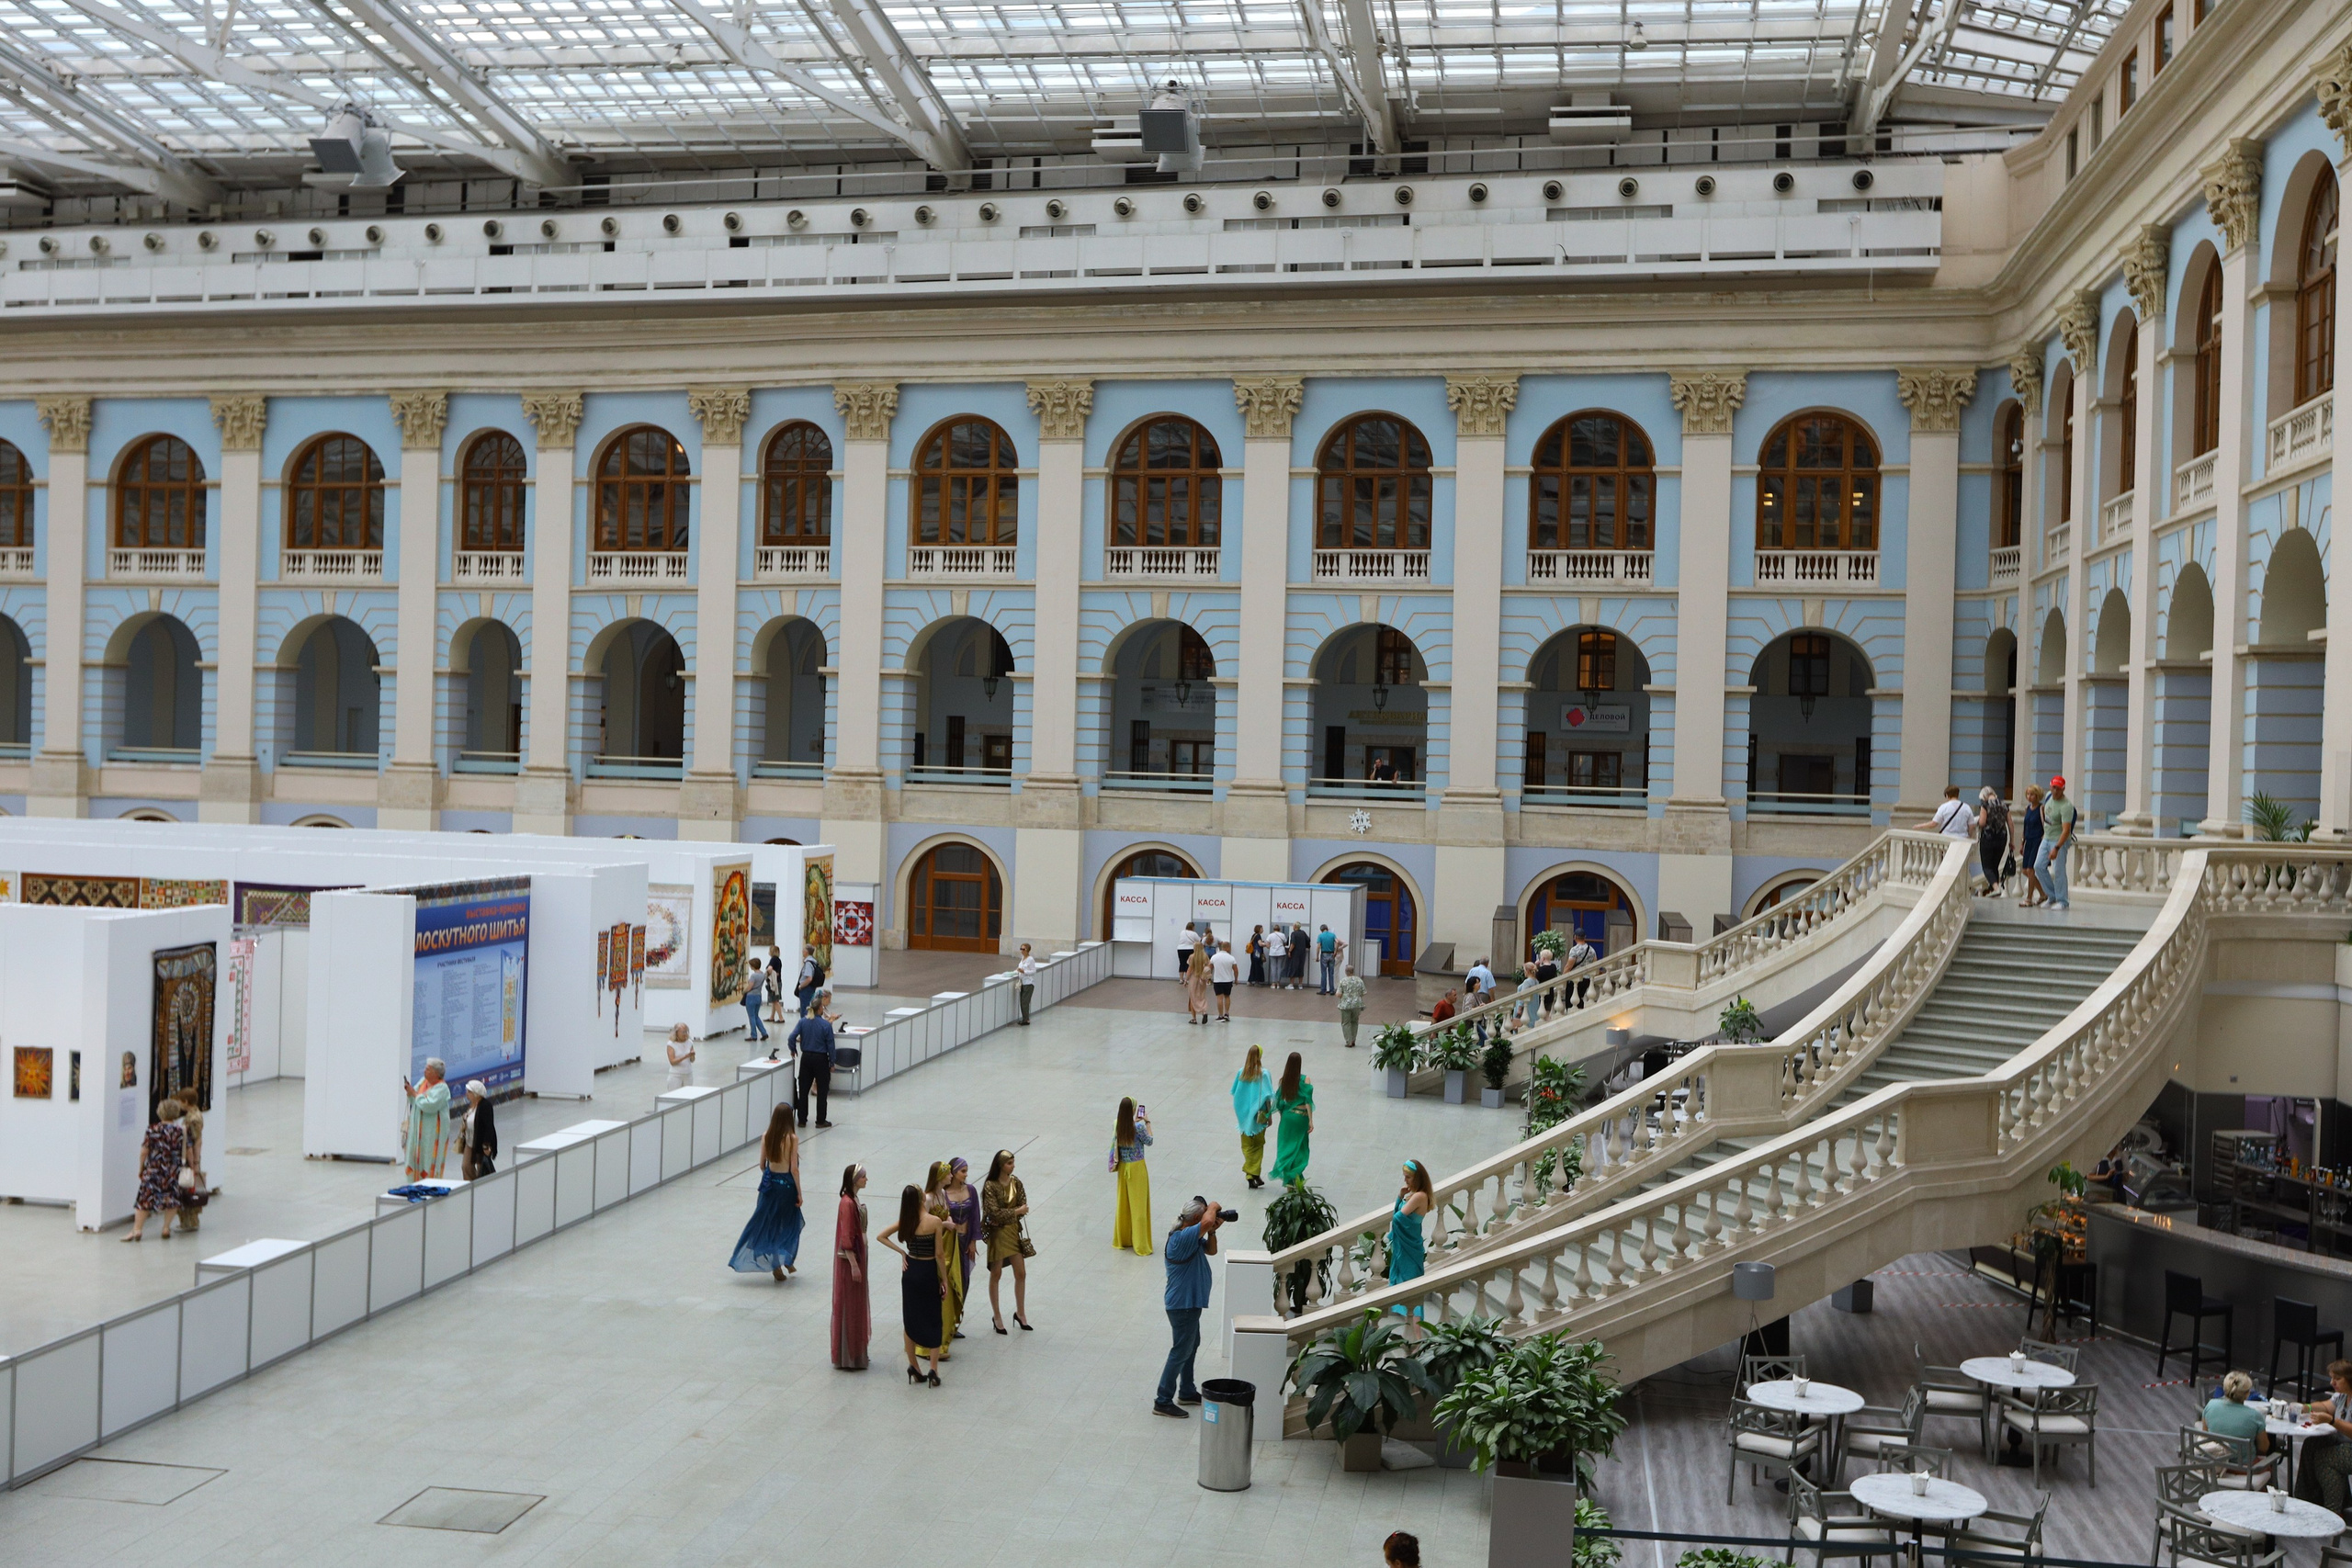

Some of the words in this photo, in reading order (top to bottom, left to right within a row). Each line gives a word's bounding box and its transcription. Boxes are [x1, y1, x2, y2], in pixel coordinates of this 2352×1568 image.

[1589, 713, 1625, 721] ДЕЛОВОЙ
[1120, 896, 1148, 904] КАССА
[1197, 898, 1226, 907] КАССА
[1276, 902, 1305, 910] КАССА
[466, 902, 526, 919] выставка-ярмарка
[414, 922, 488, 953] ЛОСКУТНОГО
[489, 917, 526, 941] ШИТЬЯ
